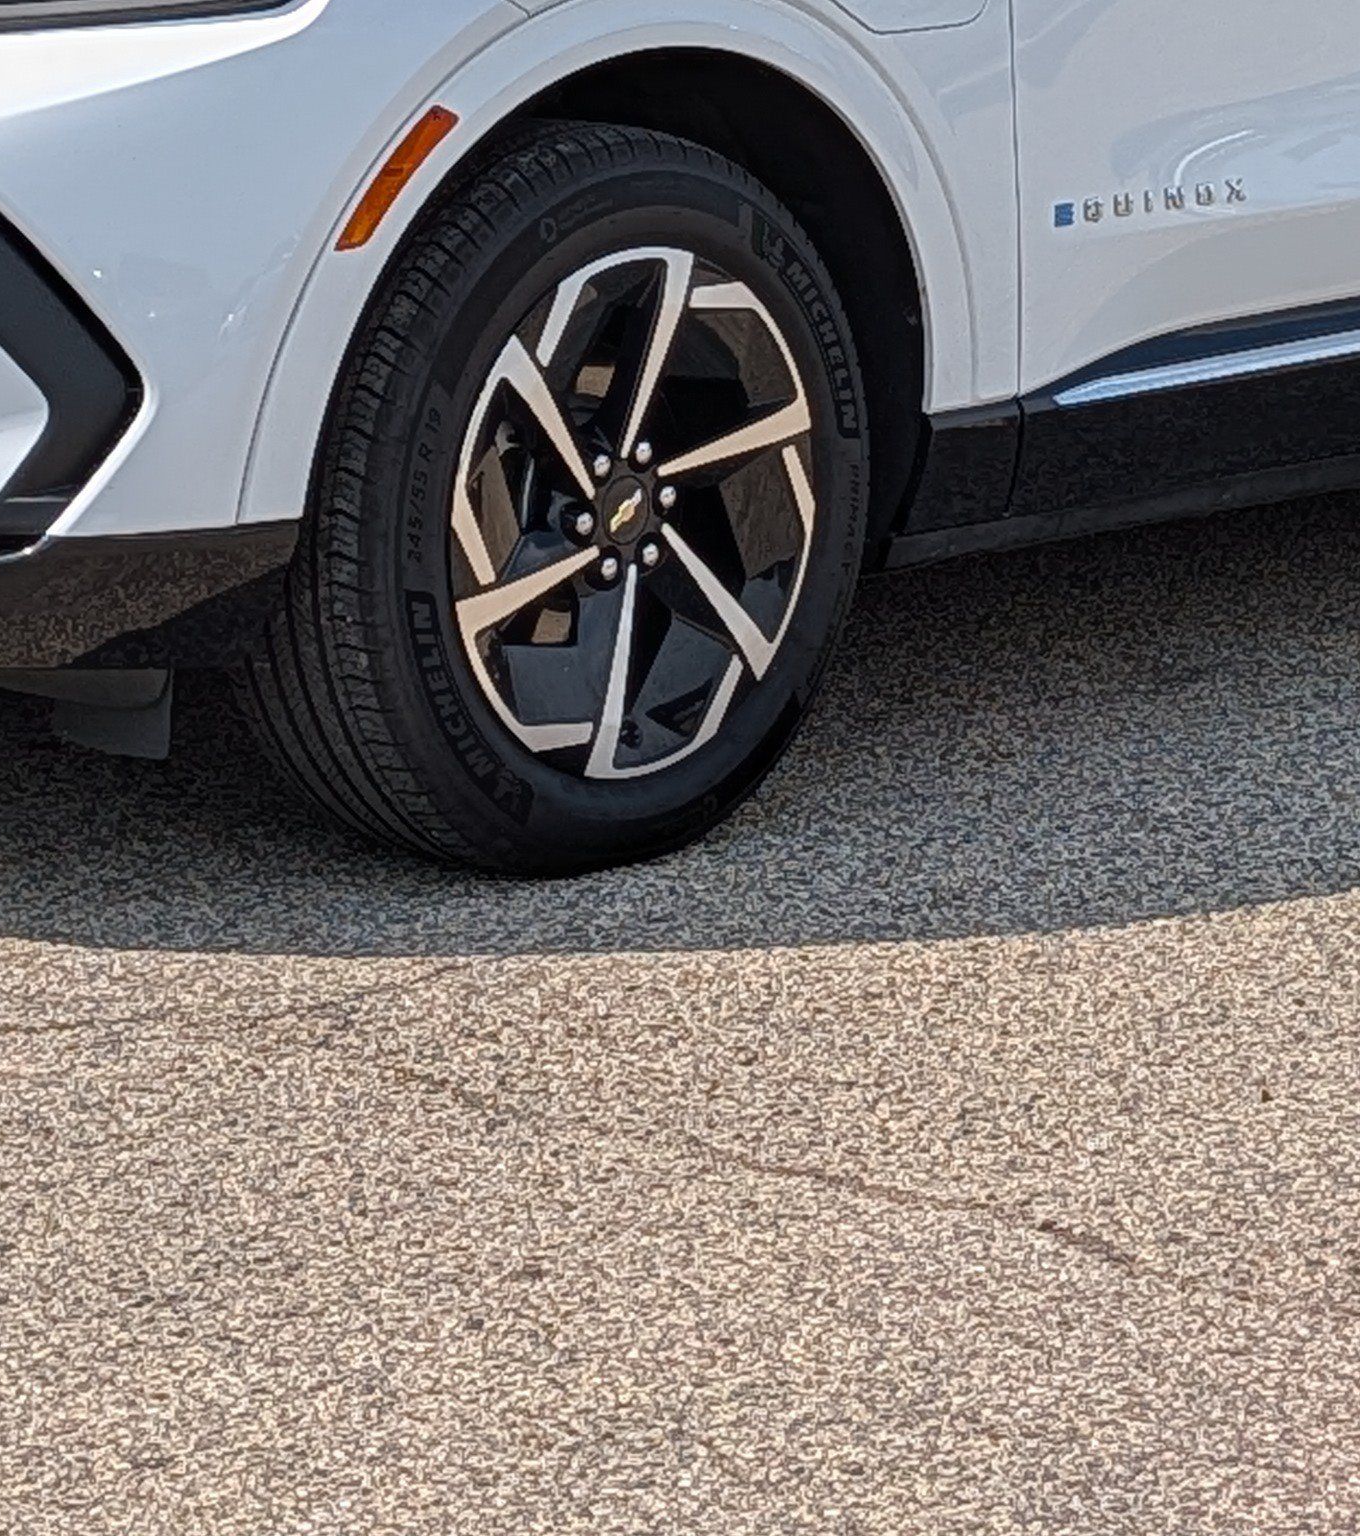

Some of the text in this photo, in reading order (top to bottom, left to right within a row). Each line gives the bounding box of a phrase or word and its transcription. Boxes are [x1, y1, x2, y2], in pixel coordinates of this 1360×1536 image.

[1054, 177, 1247, 228] EQUINOX
[784, 258, 859, 431] MICHELIN
[410, 599, 499, 780] MICHELIN
